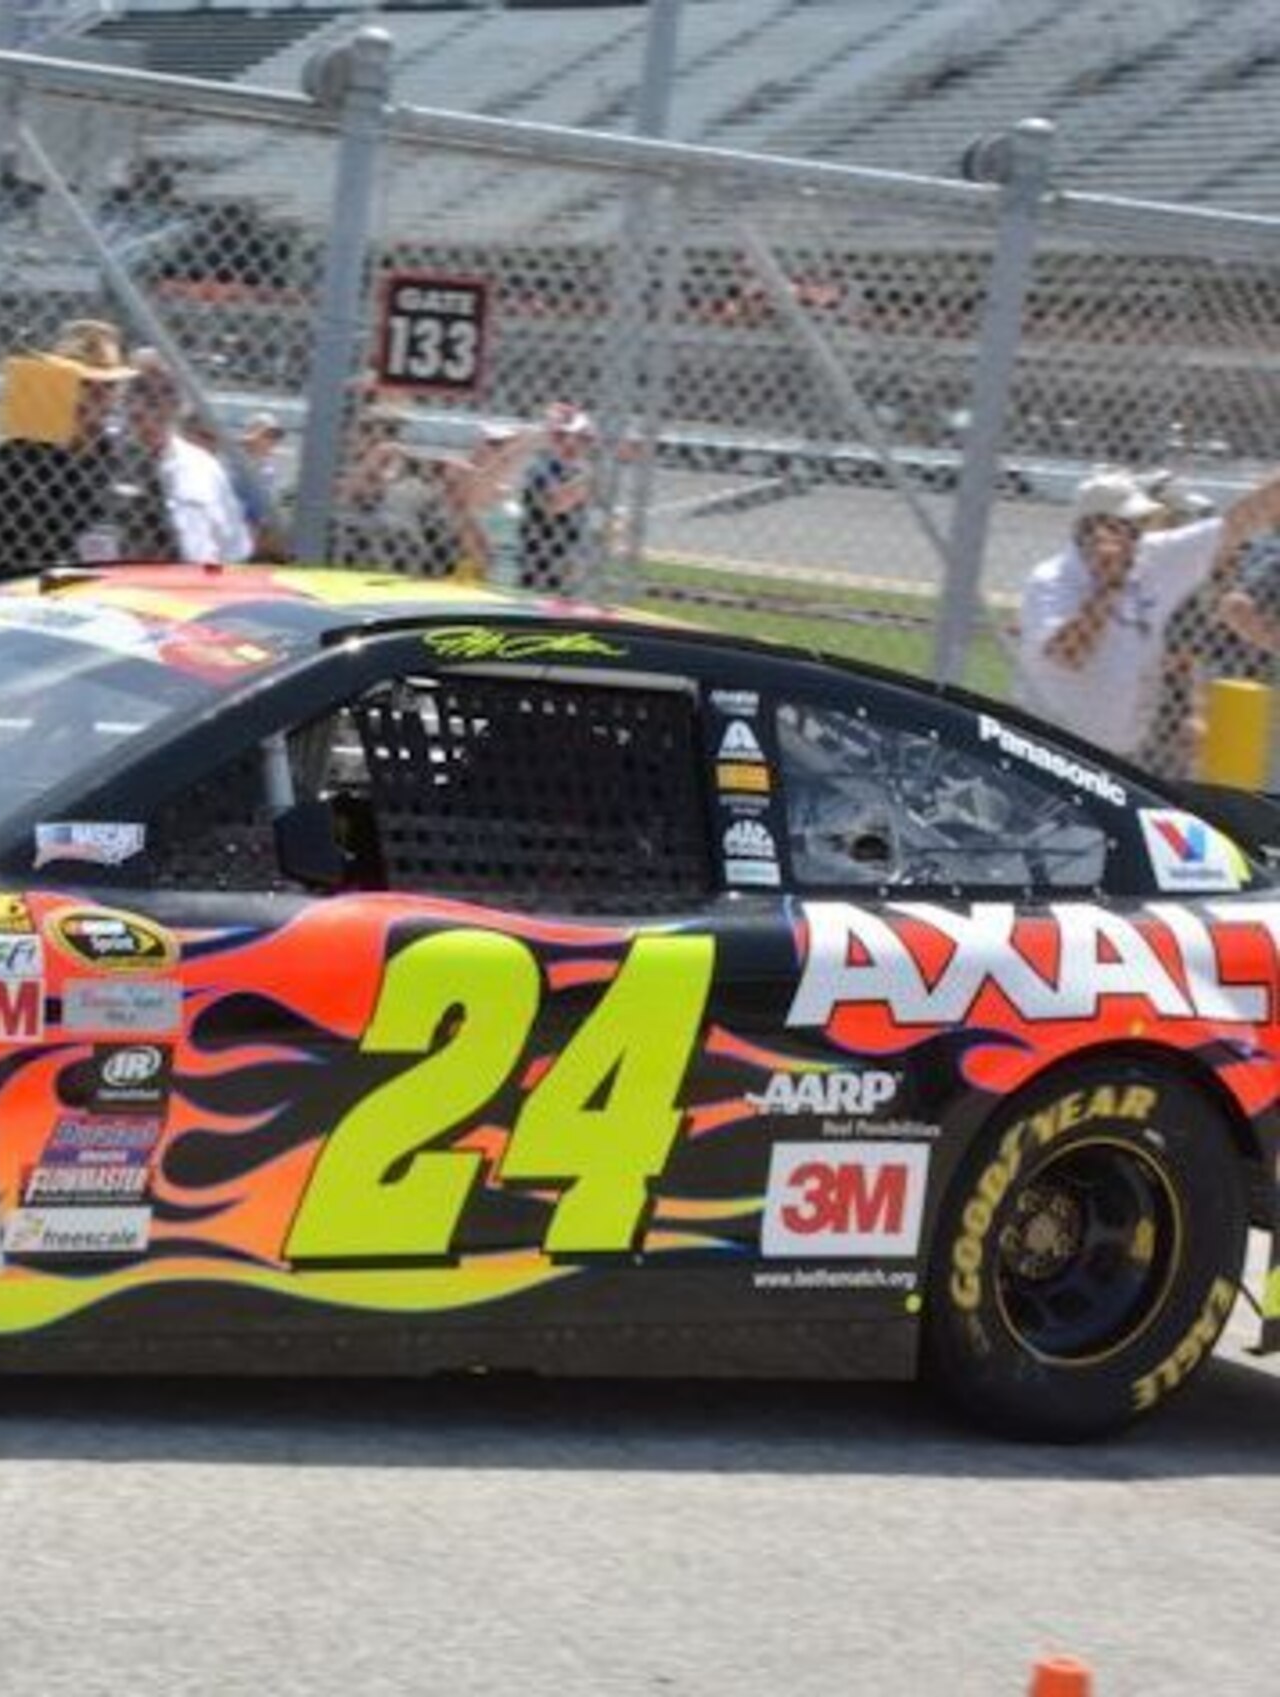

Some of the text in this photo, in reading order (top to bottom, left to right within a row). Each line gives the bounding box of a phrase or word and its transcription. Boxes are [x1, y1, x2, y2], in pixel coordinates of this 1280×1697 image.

[397, 287, 477, 317] GATE
[386, 315, 479, 382] 133
[979, 714, 1127, 806] Panasonic
[283, 928, 715, 1258] 24
[746, 1070, 898, 1115] AARP
[781, 1161, 908, 1236] 3M
[951, 1085, 1158, 1309] GOODYEAR
[44, 1222, 138, 1248] freescale
[1132, 1277, 1237, 1410] EAGLE
